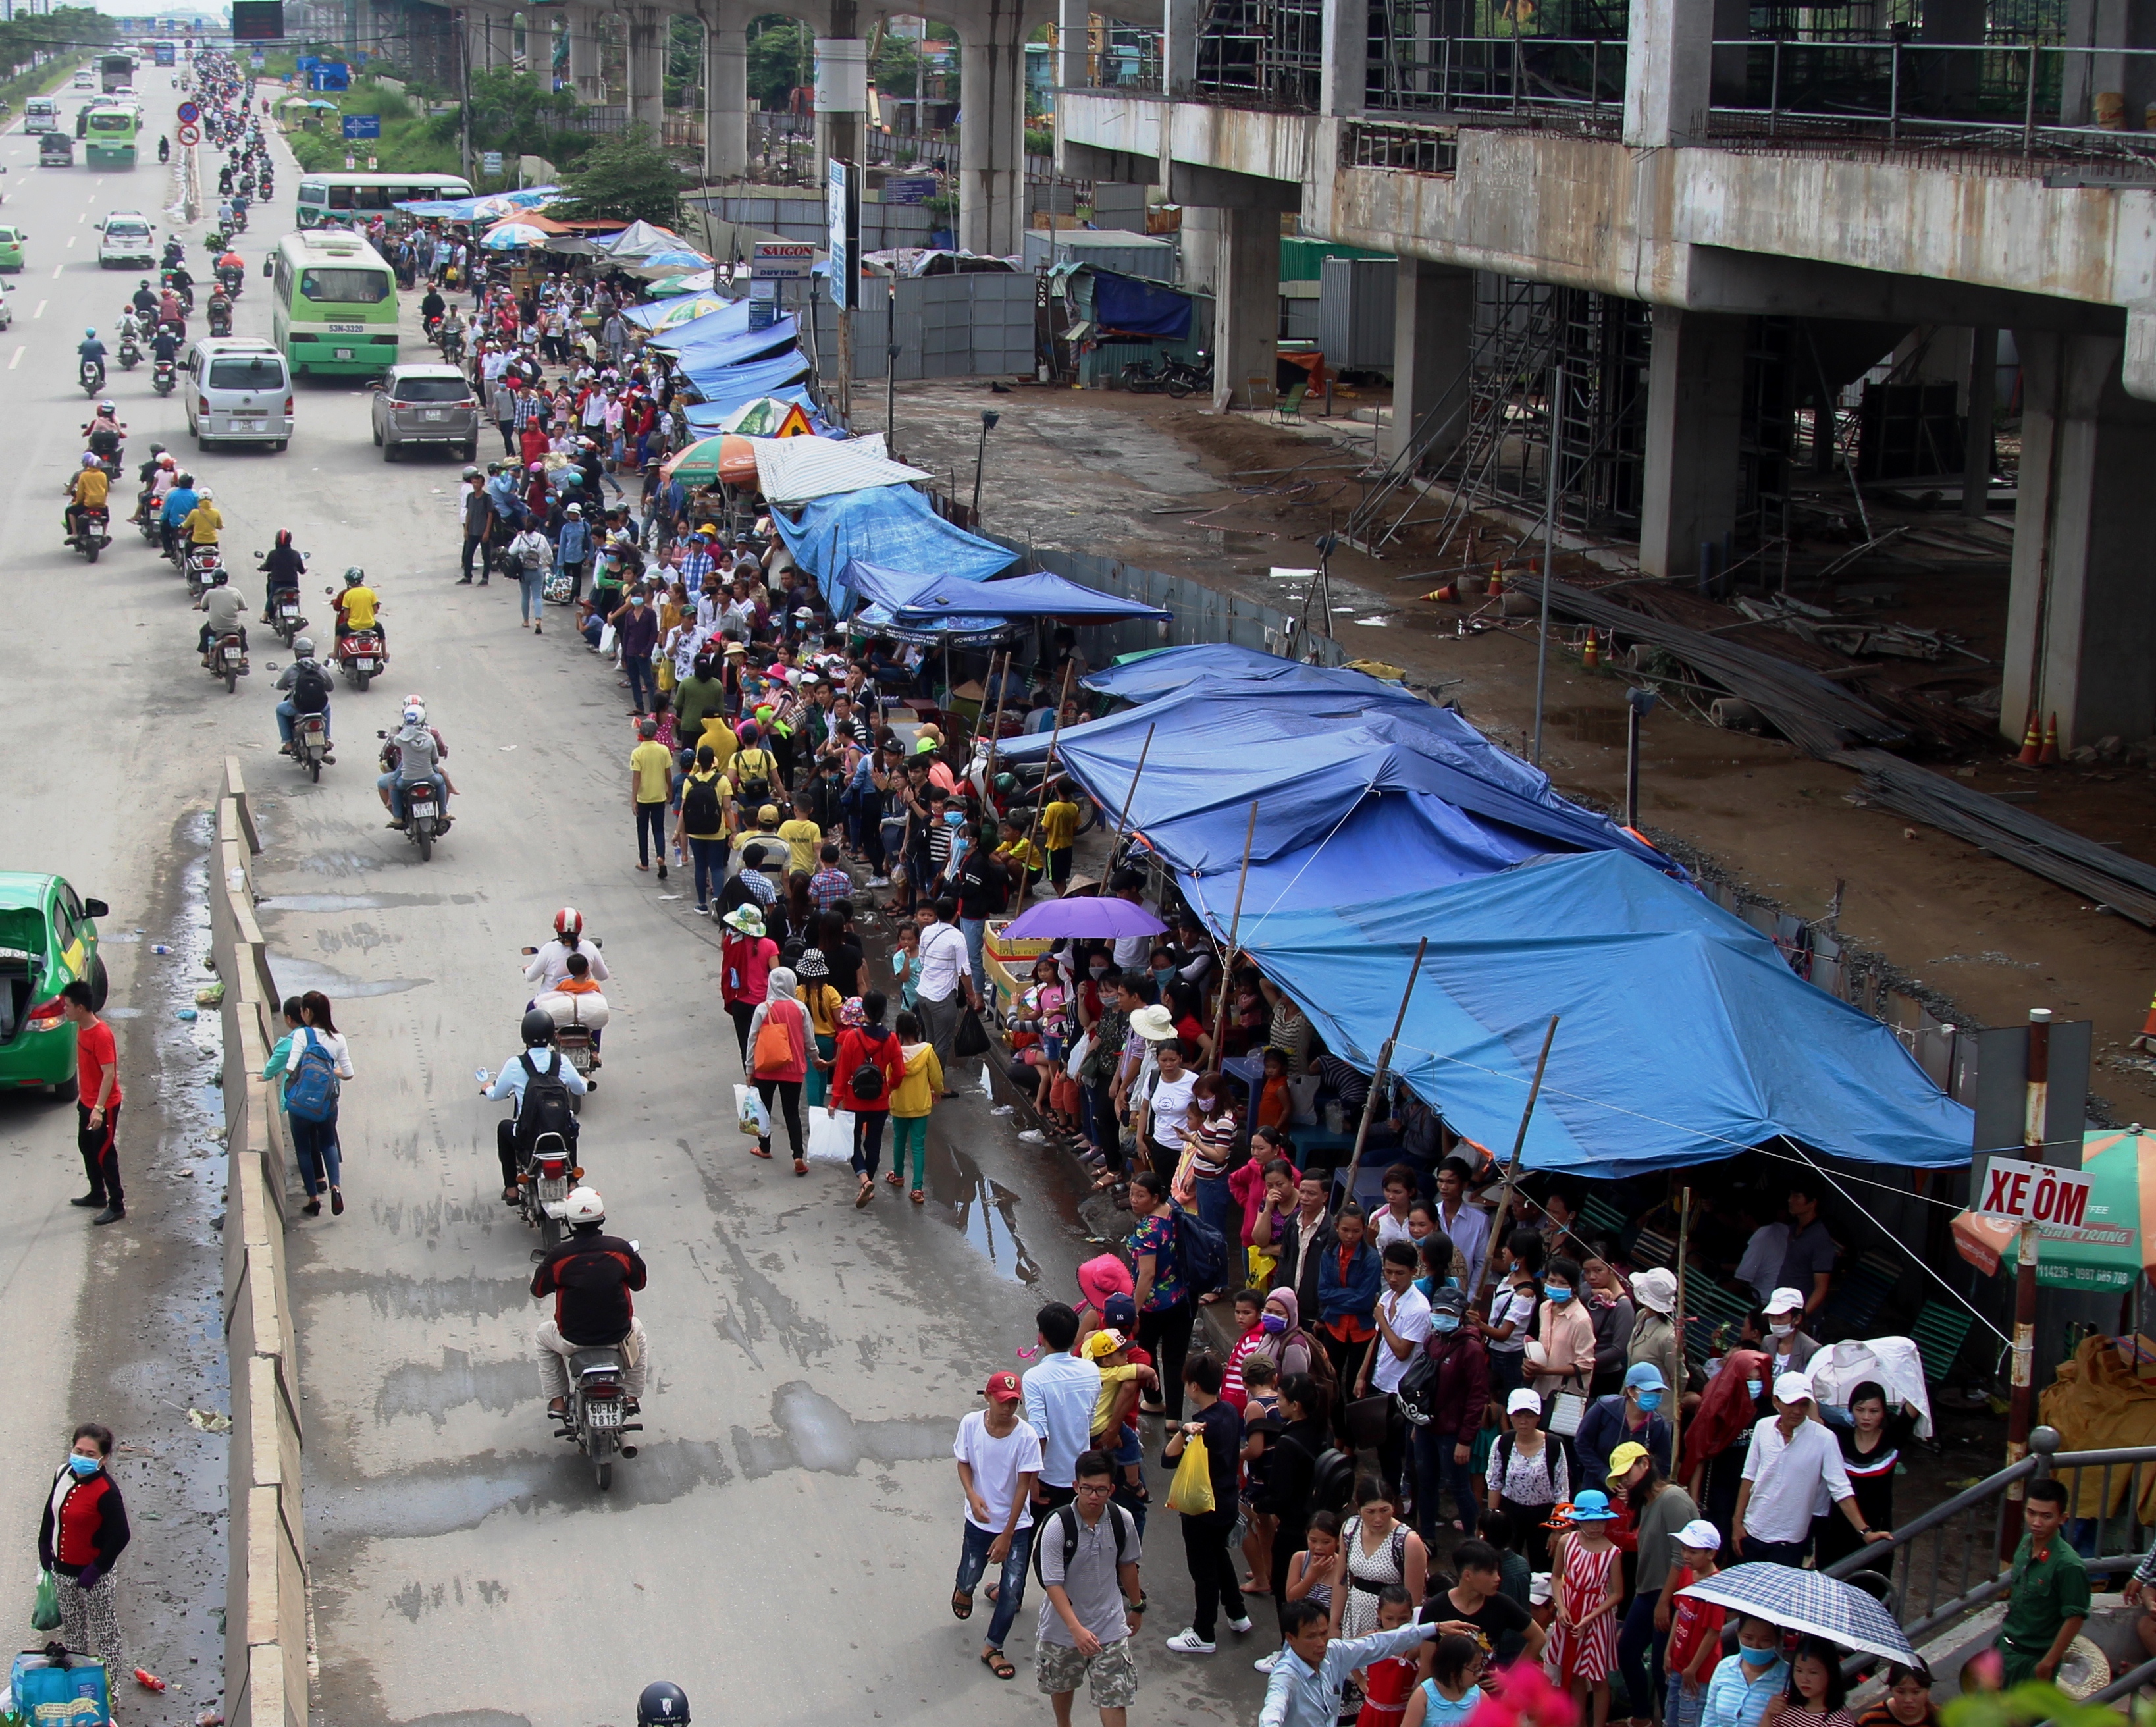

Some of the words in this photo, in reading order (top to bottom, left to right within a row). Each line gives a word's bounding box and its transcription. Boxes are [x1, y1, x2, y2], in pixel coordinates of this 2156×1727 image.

[1983, 1169, 2031, 1217] XE
[2032, 1169, 2090, 1227] ÔM
[2078, 1229, 2129, 1243] TRANG
[592, 1414, 618, 1426] 2815
